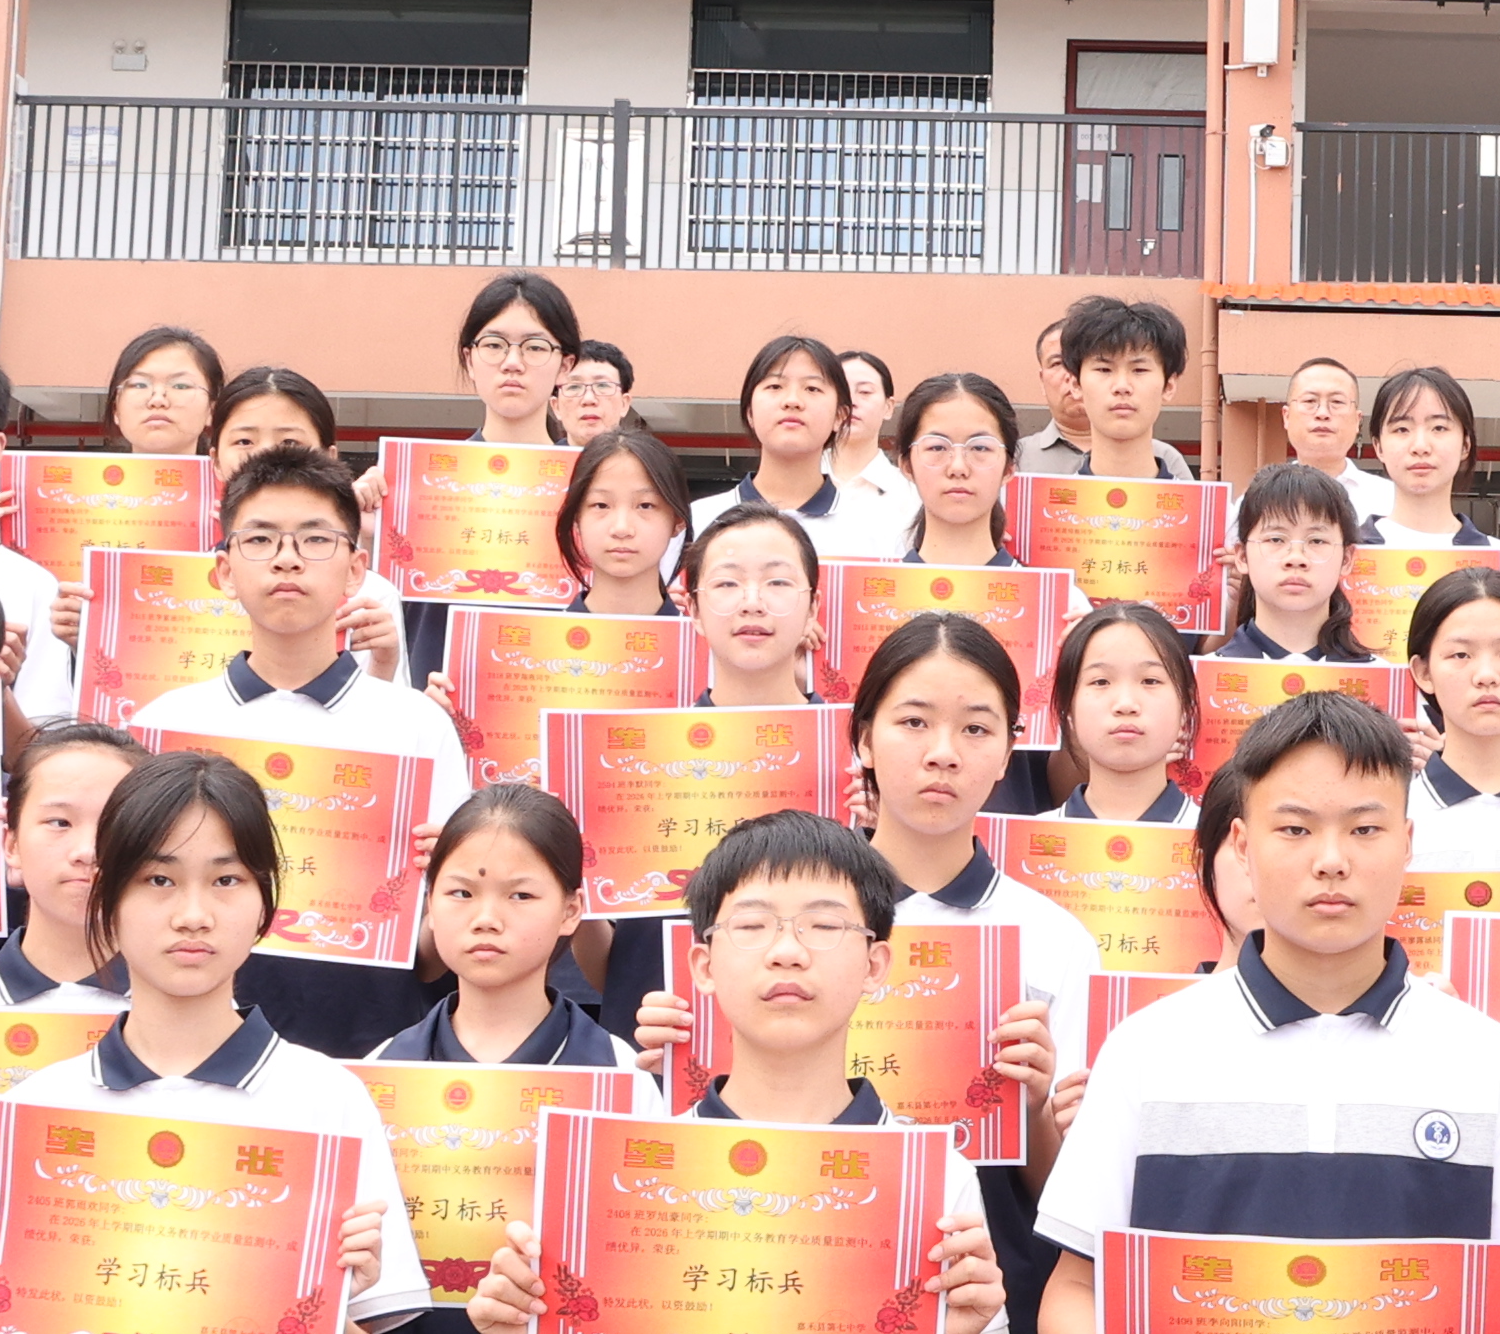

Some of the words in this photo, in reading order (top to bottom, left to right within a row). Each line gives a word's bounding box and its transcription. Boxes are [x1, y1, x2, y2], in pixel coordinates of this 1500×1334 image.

[539, 460, 566, 477] 状
[1157, 493, 1184, 509] 状
[461, 526, 530, 545] 学习标兵
[1082, 557, 1148, 576] 学习标兵
[626, 632, 657, 651] 状
[756, 723, 792, 747] 状
[334, 764, 371, 789] 状
[910, 941, 951, 967] 状
[1098, 933, 1160, 955] 习标兵
[851, 1053, 901, 1076] 标兵
[522, 1087, 564, 1111] 状
[236, 1145, 284, 1177] 状
[820, 1150, 869, 1180] 状
[405, 1197, 508, 1221] 学习标兵
[95, 1257, 211, 1295] 学习标兵
[683, 1266, 803, 1294] 学习标兵
[1380, 1258, 1429, 1281] 状
